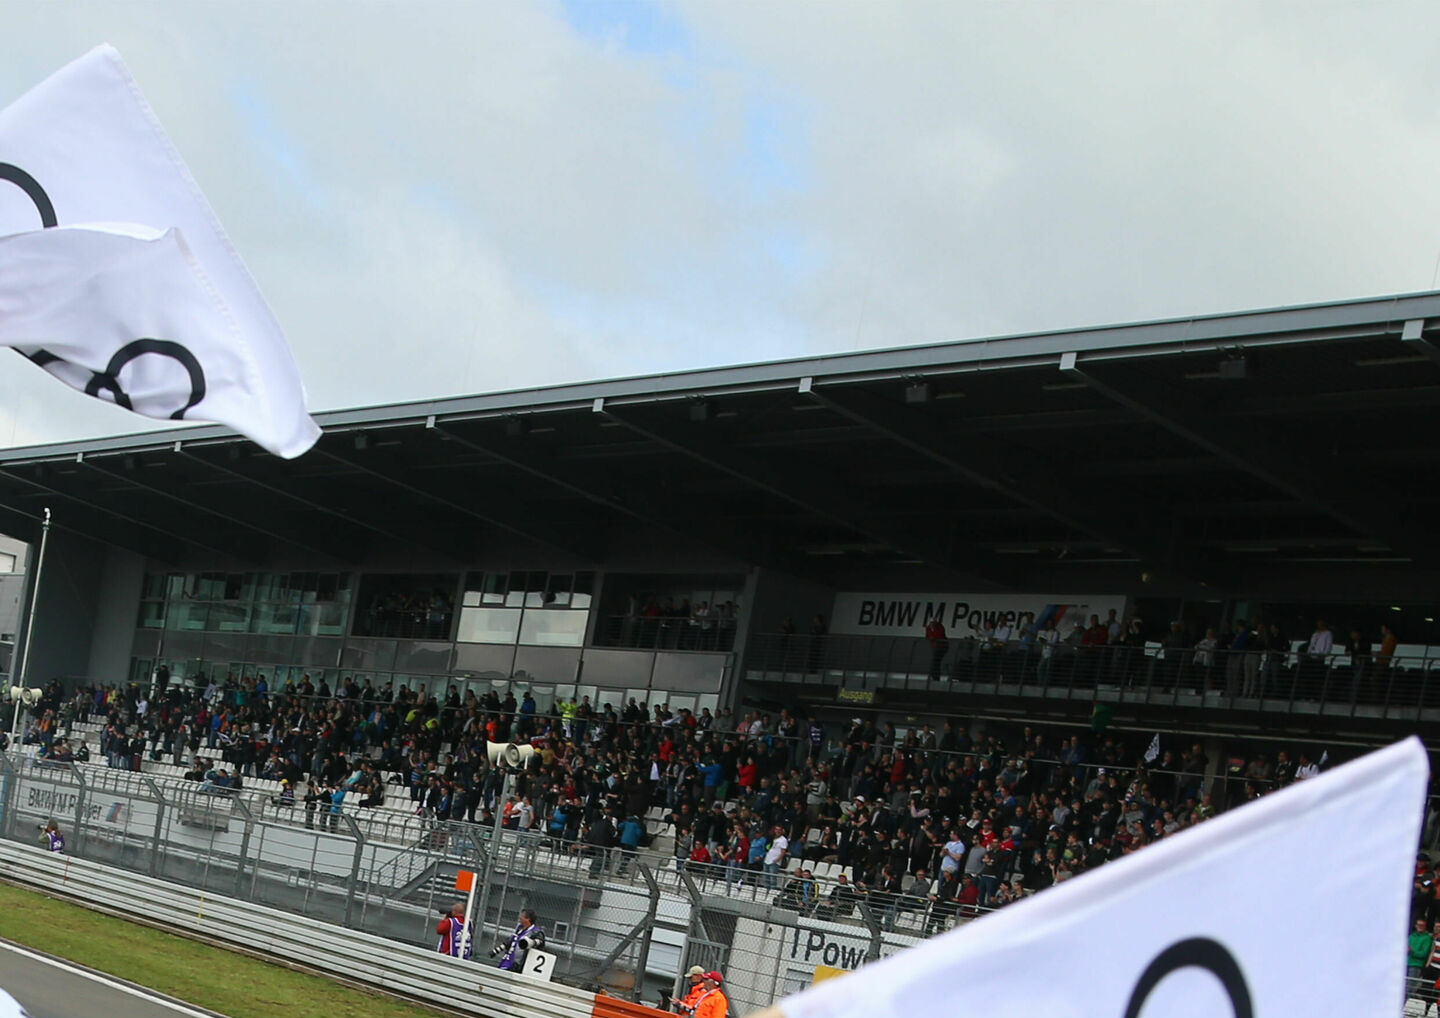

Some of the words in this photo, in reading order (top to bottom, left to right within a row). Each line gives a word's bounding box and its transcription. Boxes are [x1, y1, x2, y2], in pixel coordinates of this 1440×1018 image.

[858, 600, 920, 627] BMW
[922, 602, 946, 627] M
[951, 602, 1035, 630] Power
[841, 687, 873, 704] Ausgang
[533, 955, 546, 974] 2
